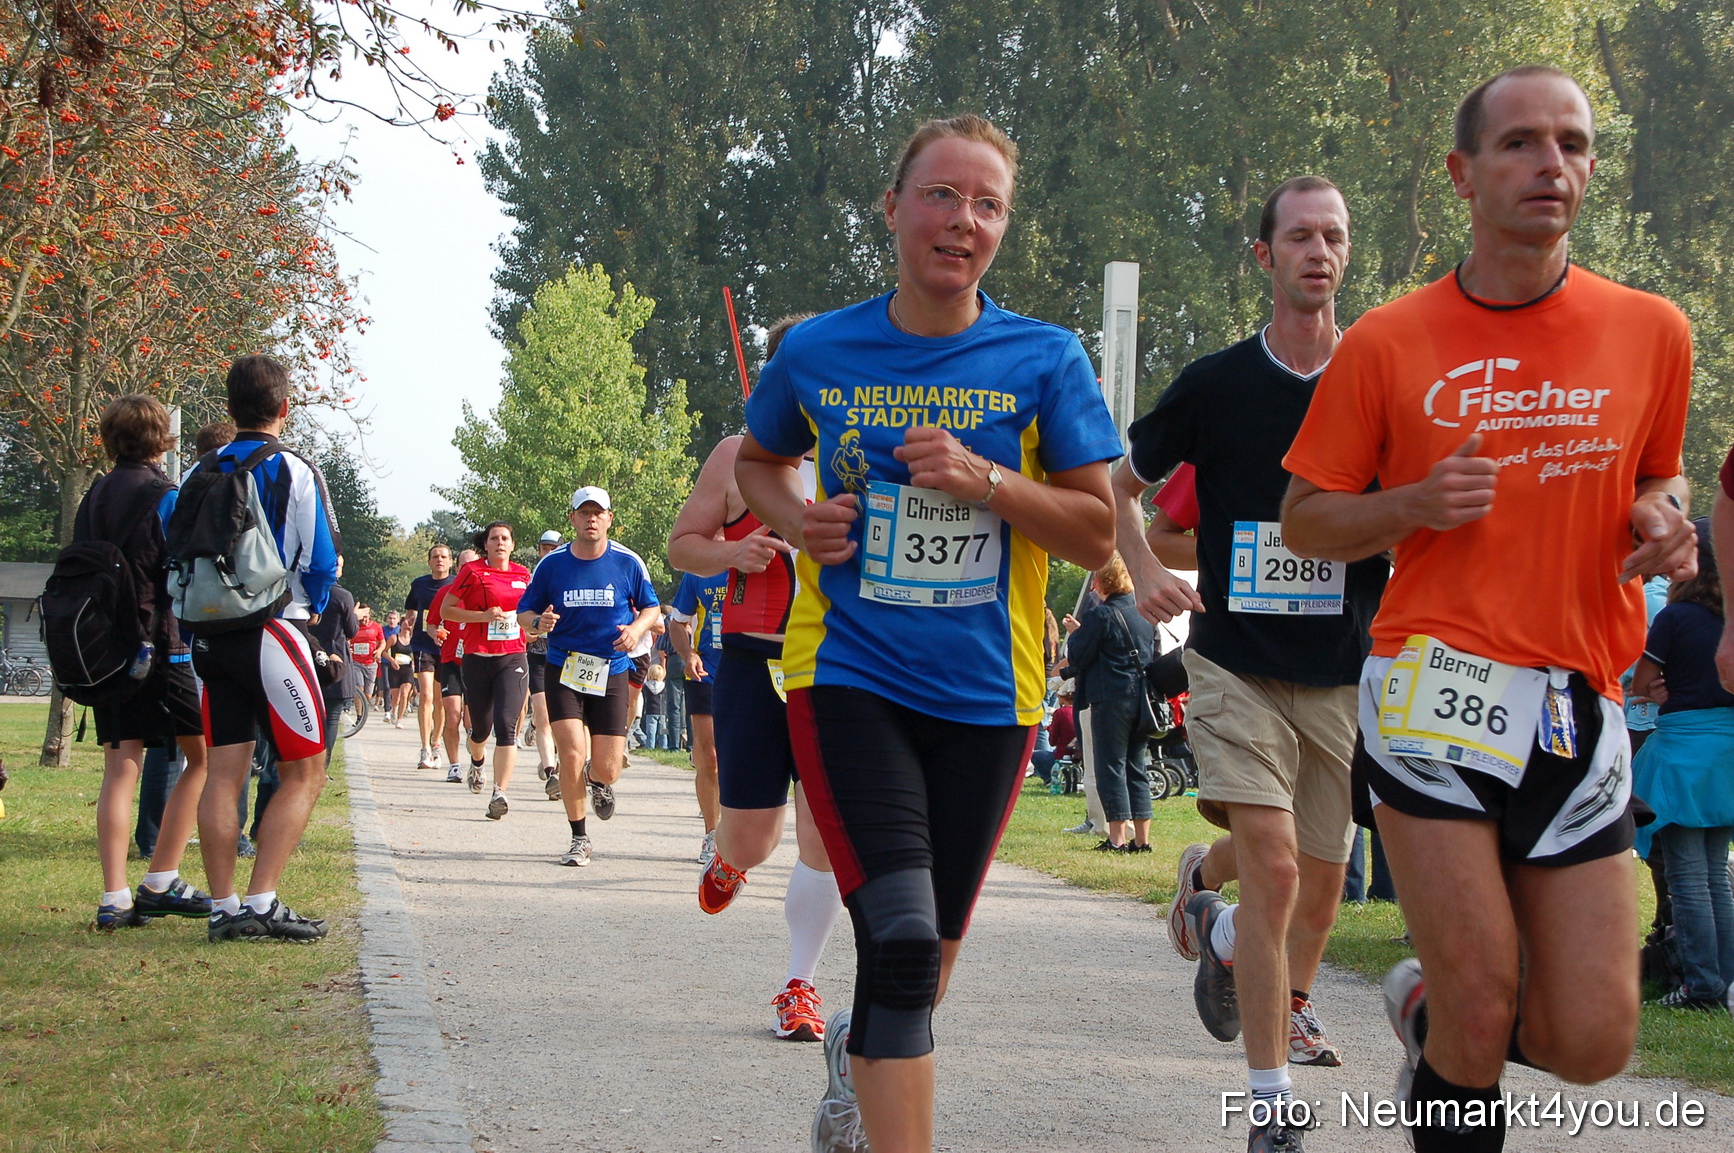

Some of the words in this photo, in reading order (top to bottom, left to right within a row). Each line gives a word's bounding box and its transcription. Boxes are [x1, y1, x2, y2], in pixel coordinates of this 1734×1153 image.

[819, 388, 847, 406] 10.
[854, 386, 1017, 413] NEUMARKTER
[1459, 381, 1611, 416] Fischer
[845, 408, 984, 430] STADTLAUF
[1475, 414, 1599, 432] AUTOMOBILE
[1496, 447, 1529, 467] und
[1532, 441, 1565, 459] das
[906, 496, 971, 522] Christa
[872, 525, 882, 541] C
[905, 532, 990, 565] 3377
[1238, 555, 1246, 568] B
[1264, 558, 1332, 582] 2986
[563, 589, 615, 602] HUBER
[949, 584, 996, 599] PFLEIDERER
[498, 621, 518, 631] 2814
[577, 656, 595, 667] Ralph
[1429, 647, 1492, 683] Bernd
[579, 668, 600, 683] 281
[1388, 677, 1398, 695] C
[1434, 687, 1509, 735] 386
[1466, 748, 1521, 776] PFLEIDERER
